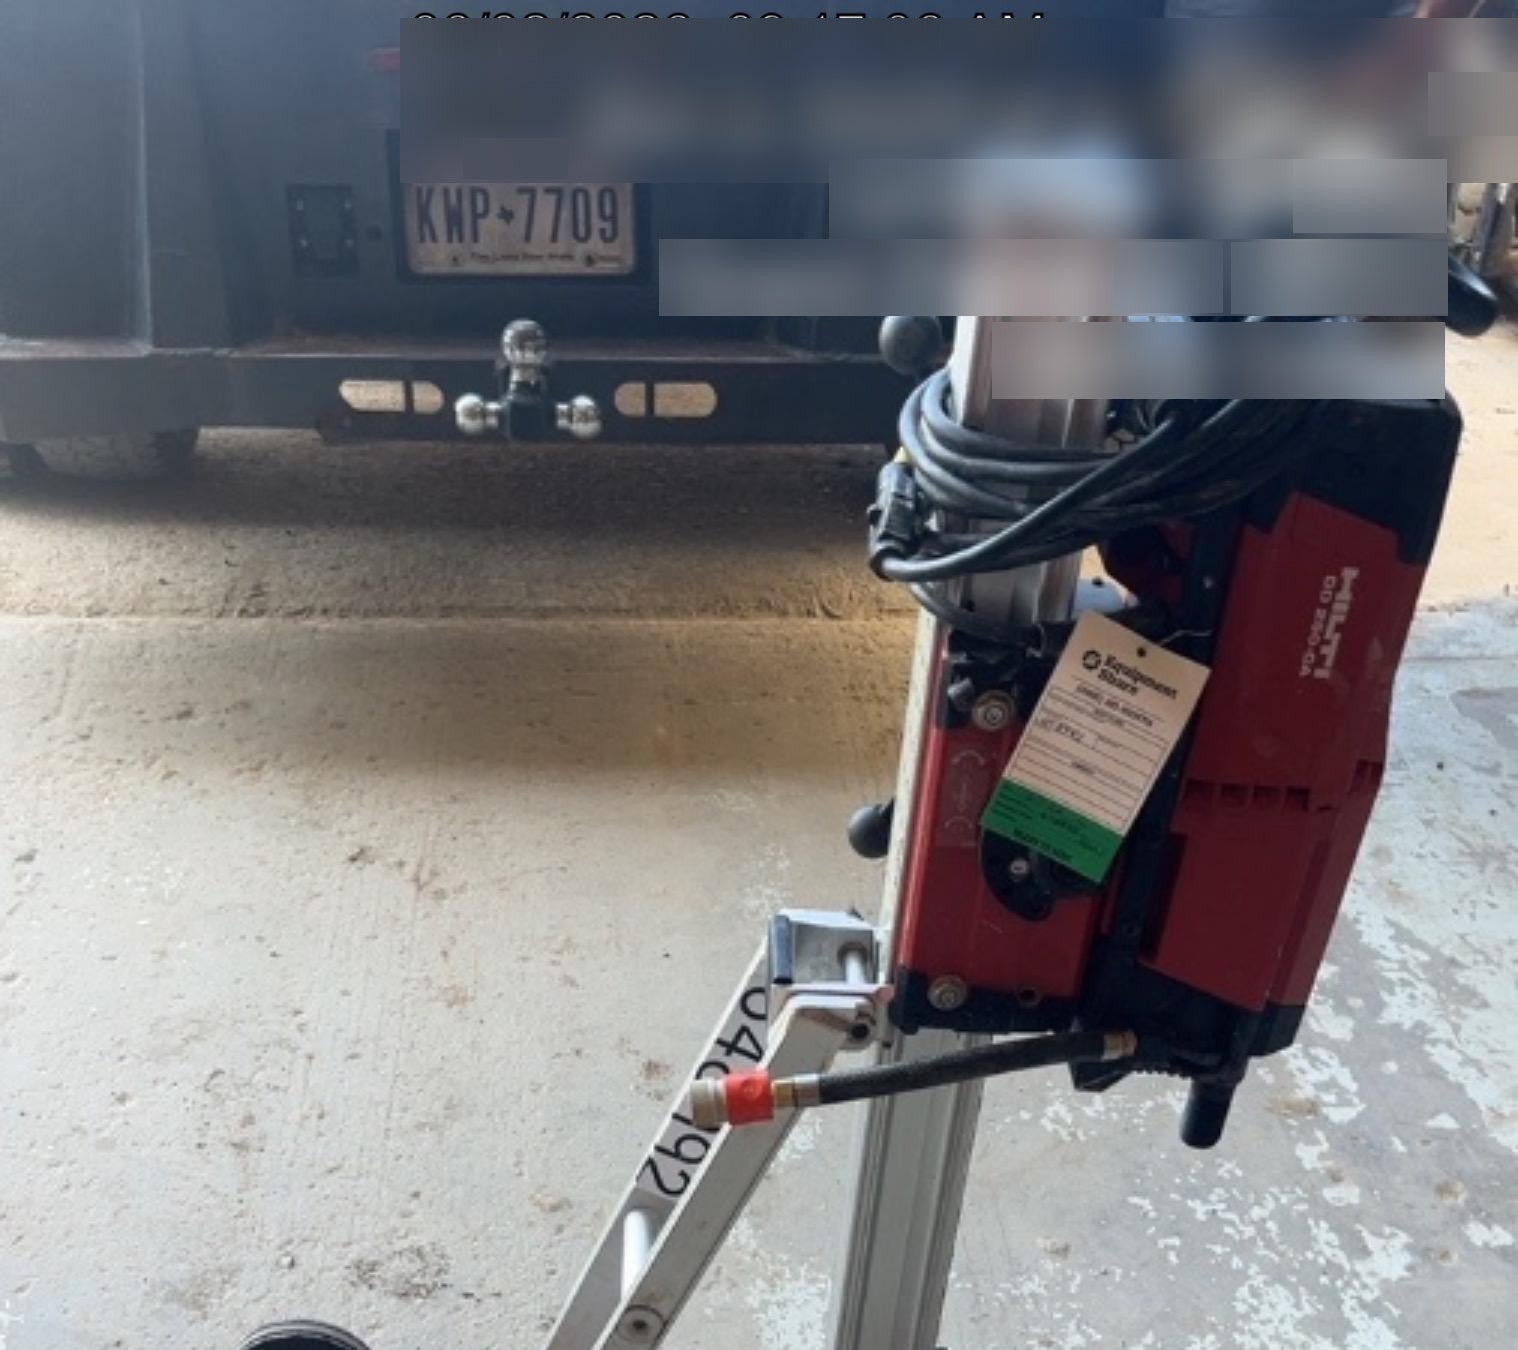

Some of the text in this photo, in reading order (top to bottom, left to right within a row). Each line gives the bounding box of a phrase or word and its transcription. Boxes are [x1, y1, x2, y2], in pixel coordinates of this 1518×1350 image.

[416, 185, 618, 243] KWP 7709
[1313, 566, 1360, 679] HILTI
[1097, 667, 1140, 697] Share
[1103, 654, 1178, 700] Equipment
